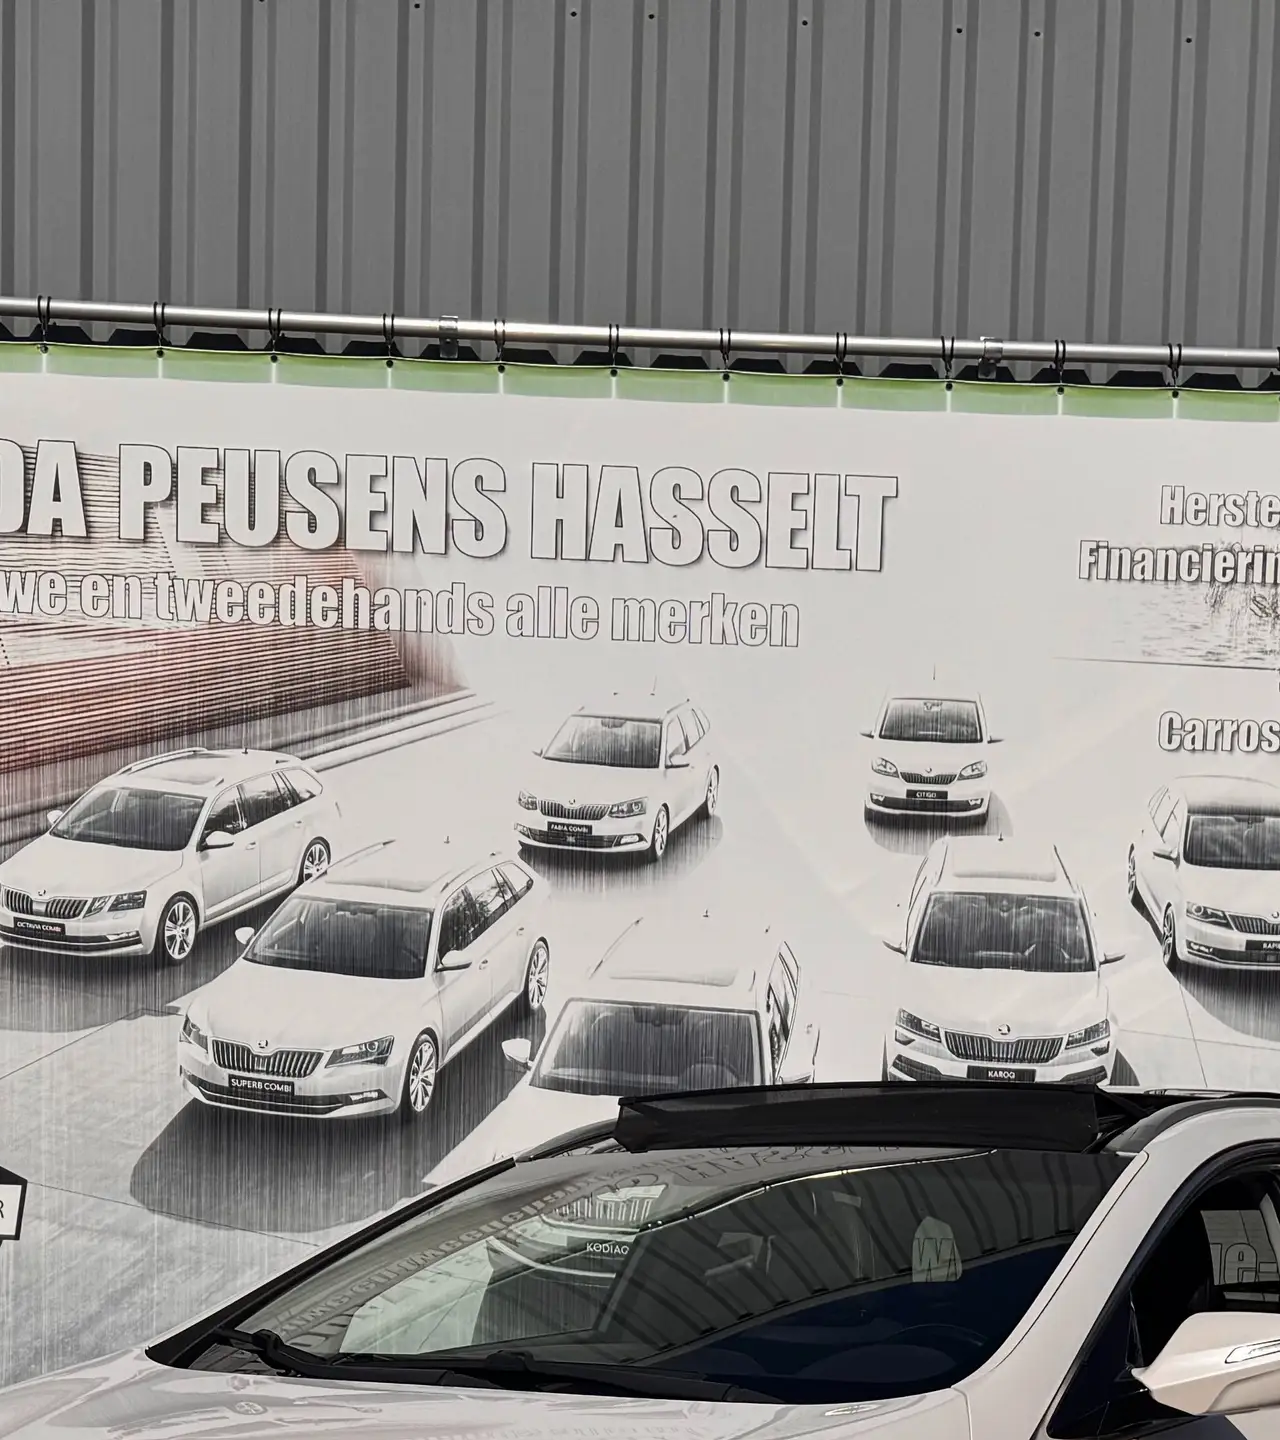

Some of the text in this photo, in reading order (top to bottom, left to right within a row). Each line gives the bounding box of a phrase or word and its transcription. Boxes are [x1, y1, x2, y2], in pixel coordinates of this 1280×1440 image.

[119, 443, 508, 560] PEUSENS
[530, 461, 898, 572] HASSELT
[80, 573, 142, 620] en
[154, 571, 495, 636] tweedehands
[506, 585, 600, 641] alle
[611, 592, 800, 648] merken
[550, 823, 589, 833] FABIA COMBI
[16, 921, 42, 930] OCTAVIA
[987, 1070, 1016, 1079] KAROQ
[231, 1078, 292, 1093] SUPERB COMBI
